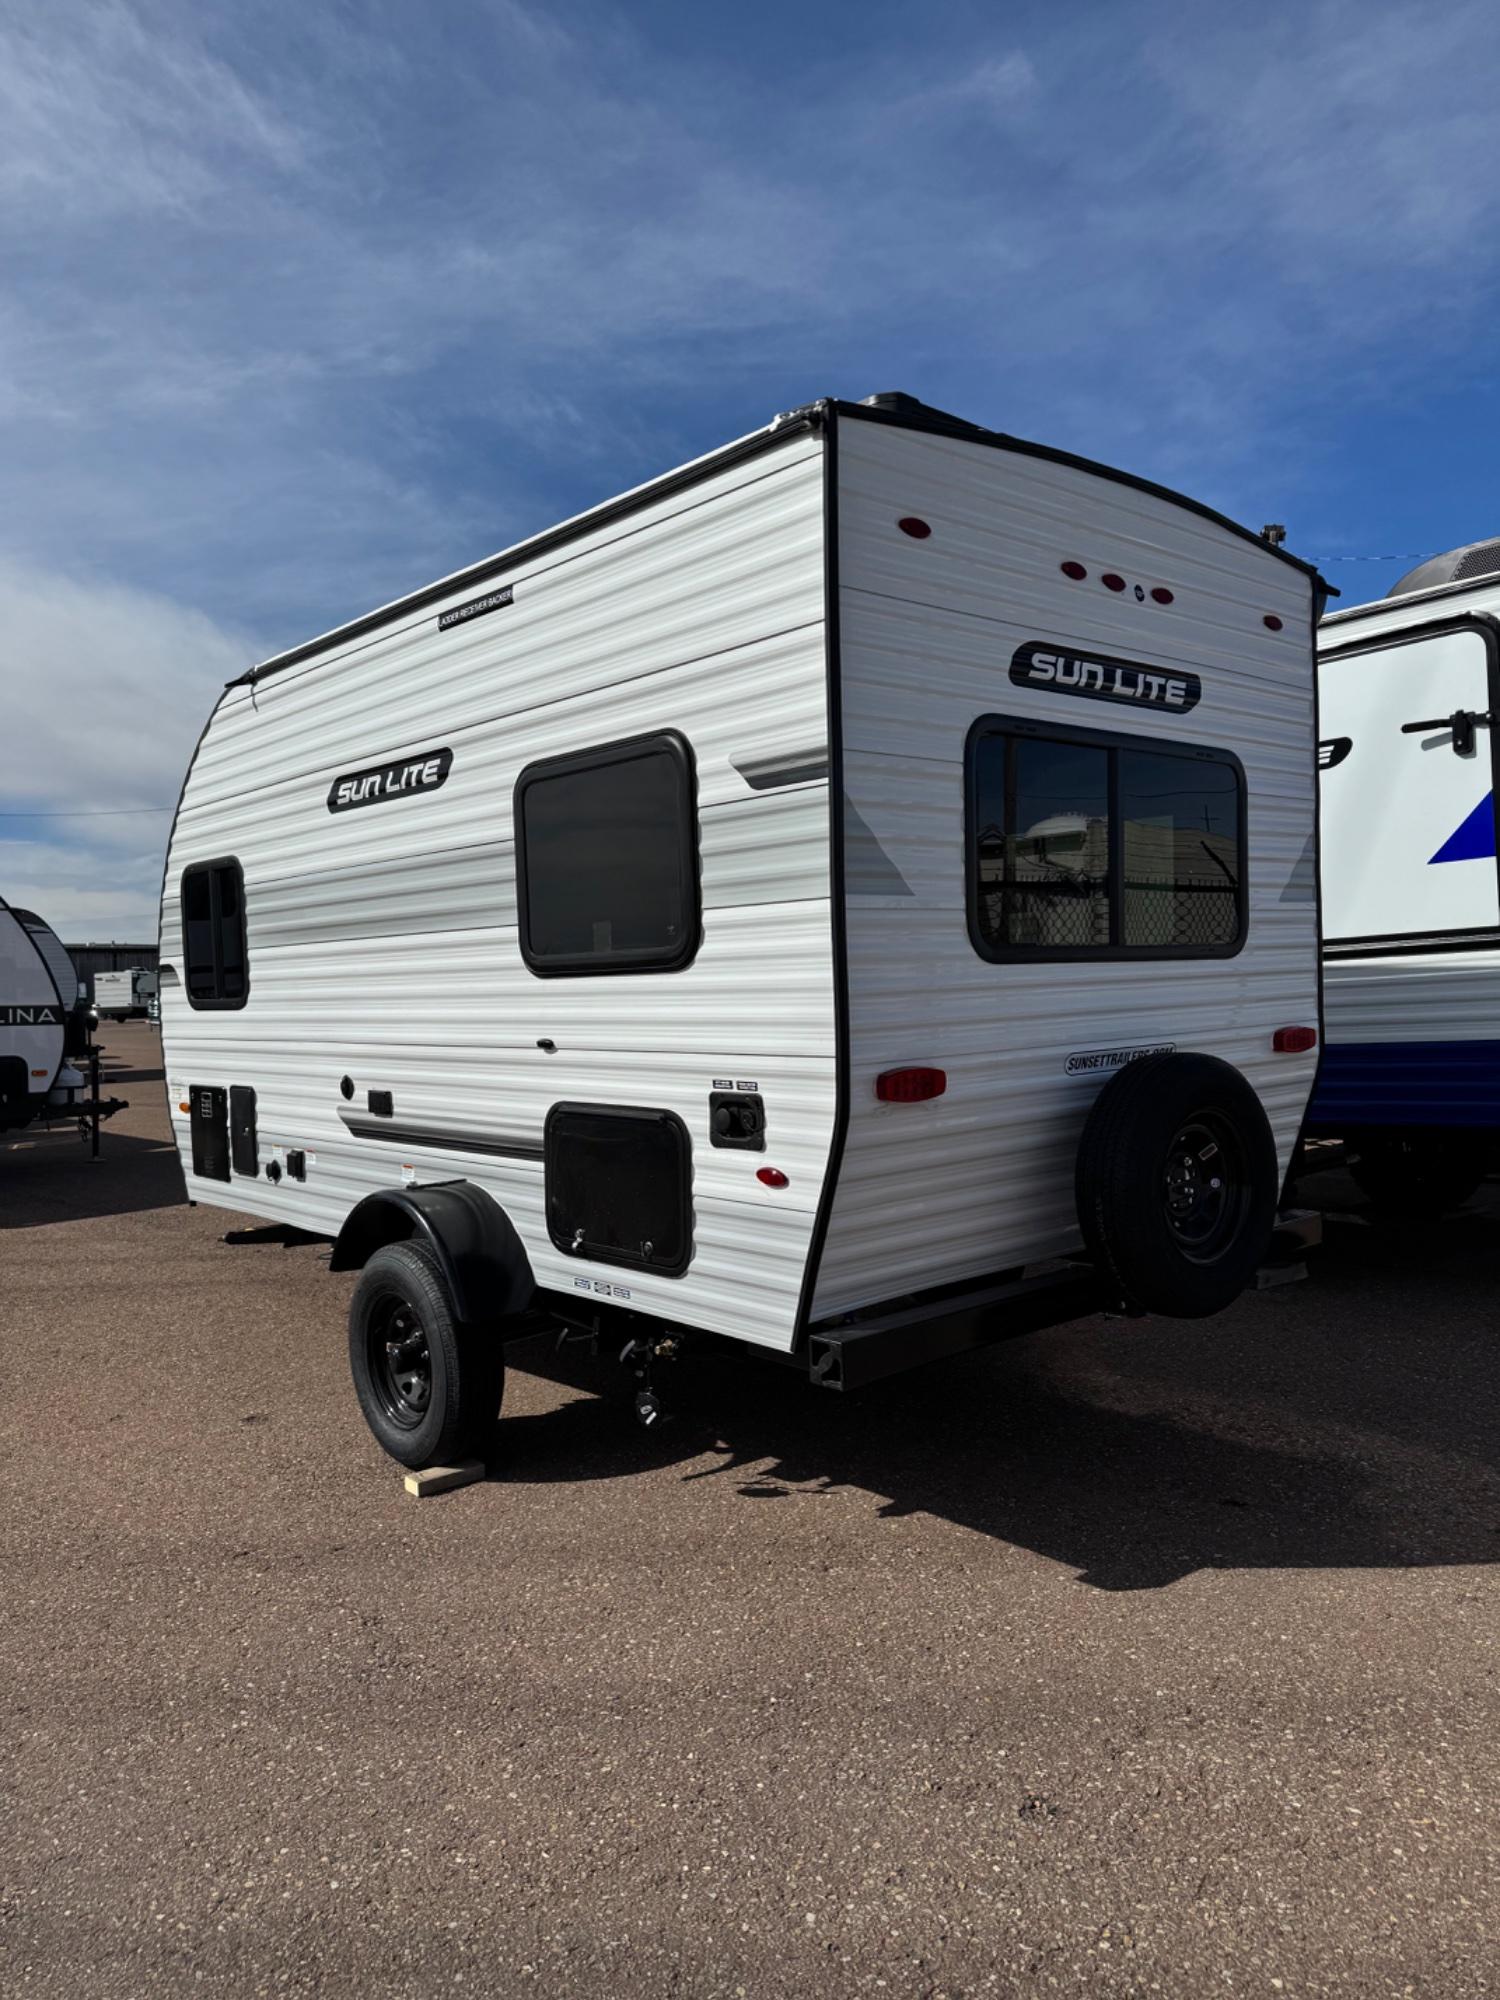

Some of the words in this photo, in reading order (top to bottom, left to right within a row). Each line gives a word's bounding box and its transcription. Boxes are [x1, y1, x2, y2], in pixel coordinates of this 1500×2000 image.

[1028, 652, 1104, 690] SUN
[1112, 668, 1187, 705] LITE
[336, 774, 381, 805] SUN
[385, 758, 441, 793] LITE
